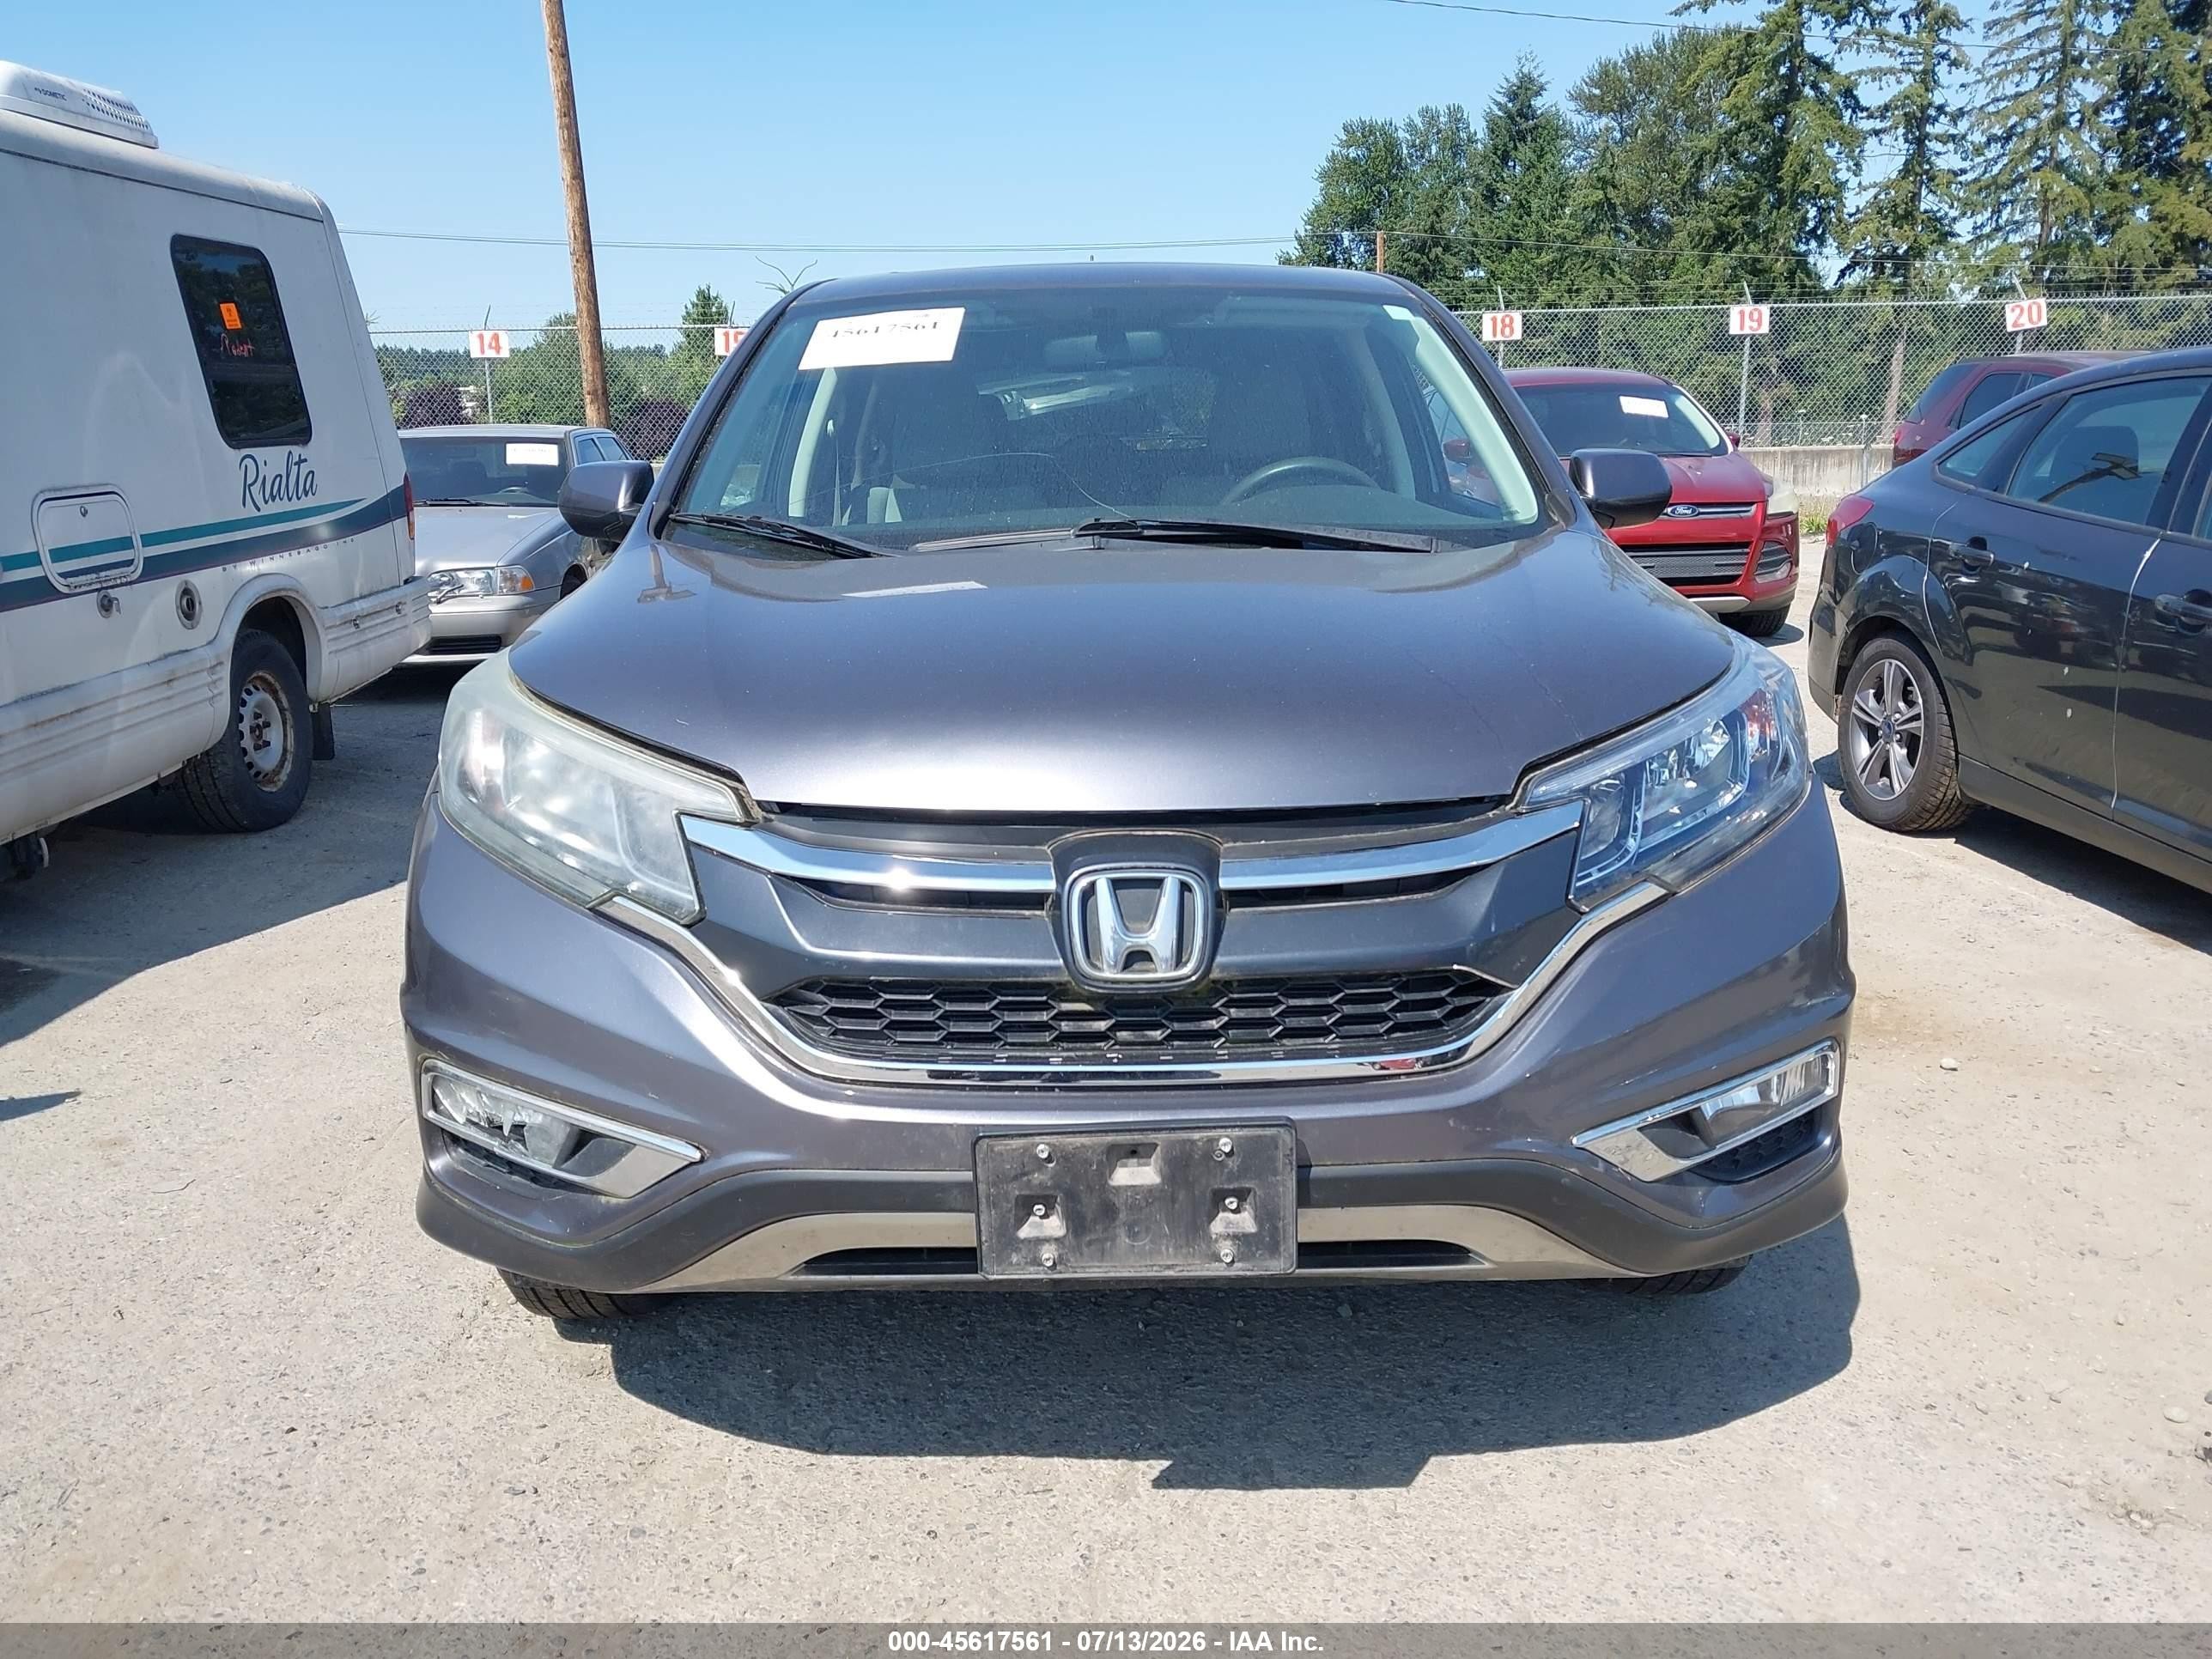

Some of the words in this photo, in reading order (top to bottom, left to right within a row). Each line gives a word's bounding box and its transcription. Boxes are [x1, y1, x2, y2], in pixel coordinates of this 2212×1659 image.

[1491, 314, 1514, 338] 18
[1739, 308, 1763, 331] 19
[2011, 301, 2042, 328] 20
[477, 332, 501, 355] 14
[239, 450, 318, 513] Rialta
[250, 544, 328, 567] WINNEBAGO
